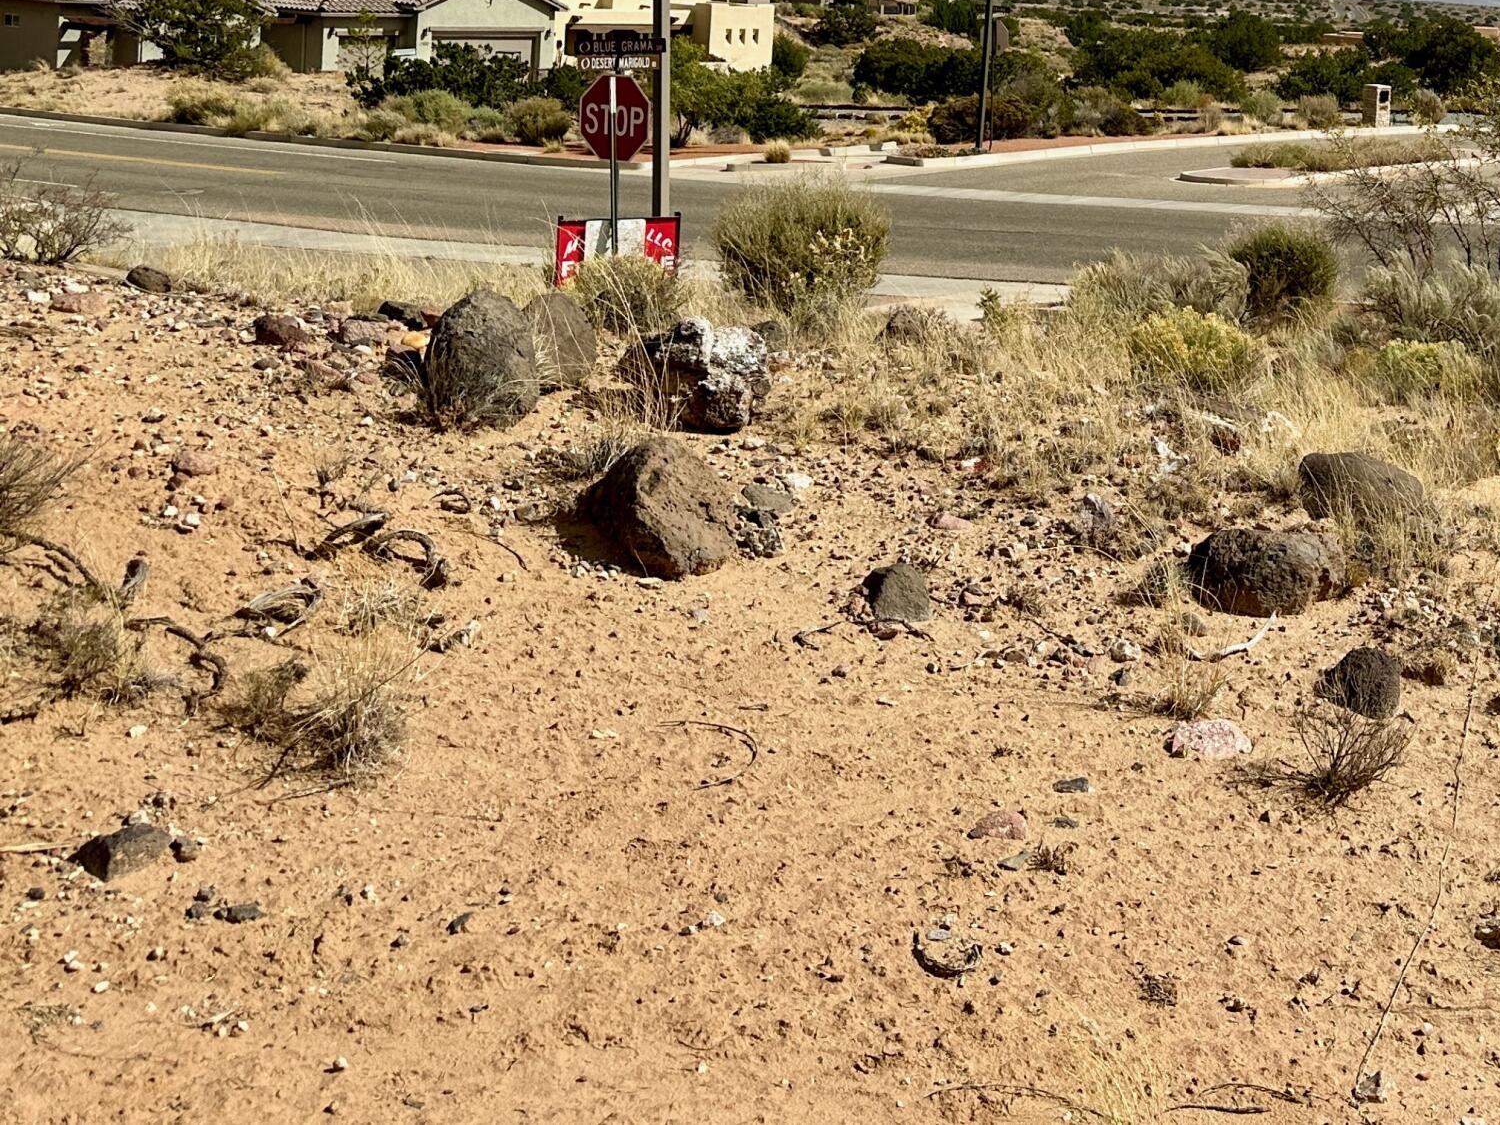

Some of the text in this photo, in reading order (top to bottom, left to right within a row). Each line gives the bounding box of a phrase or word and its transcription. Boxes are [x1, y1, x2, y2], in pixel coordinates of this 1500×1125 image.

[593, 41, 616, 52] BLUE
[621, 40, 653, 52] GRAMA
[591, 57, 616, 69] DESERT
[618, 57, 650, 68] MARIGOLD
[584, 102, 644, 137] STOP
